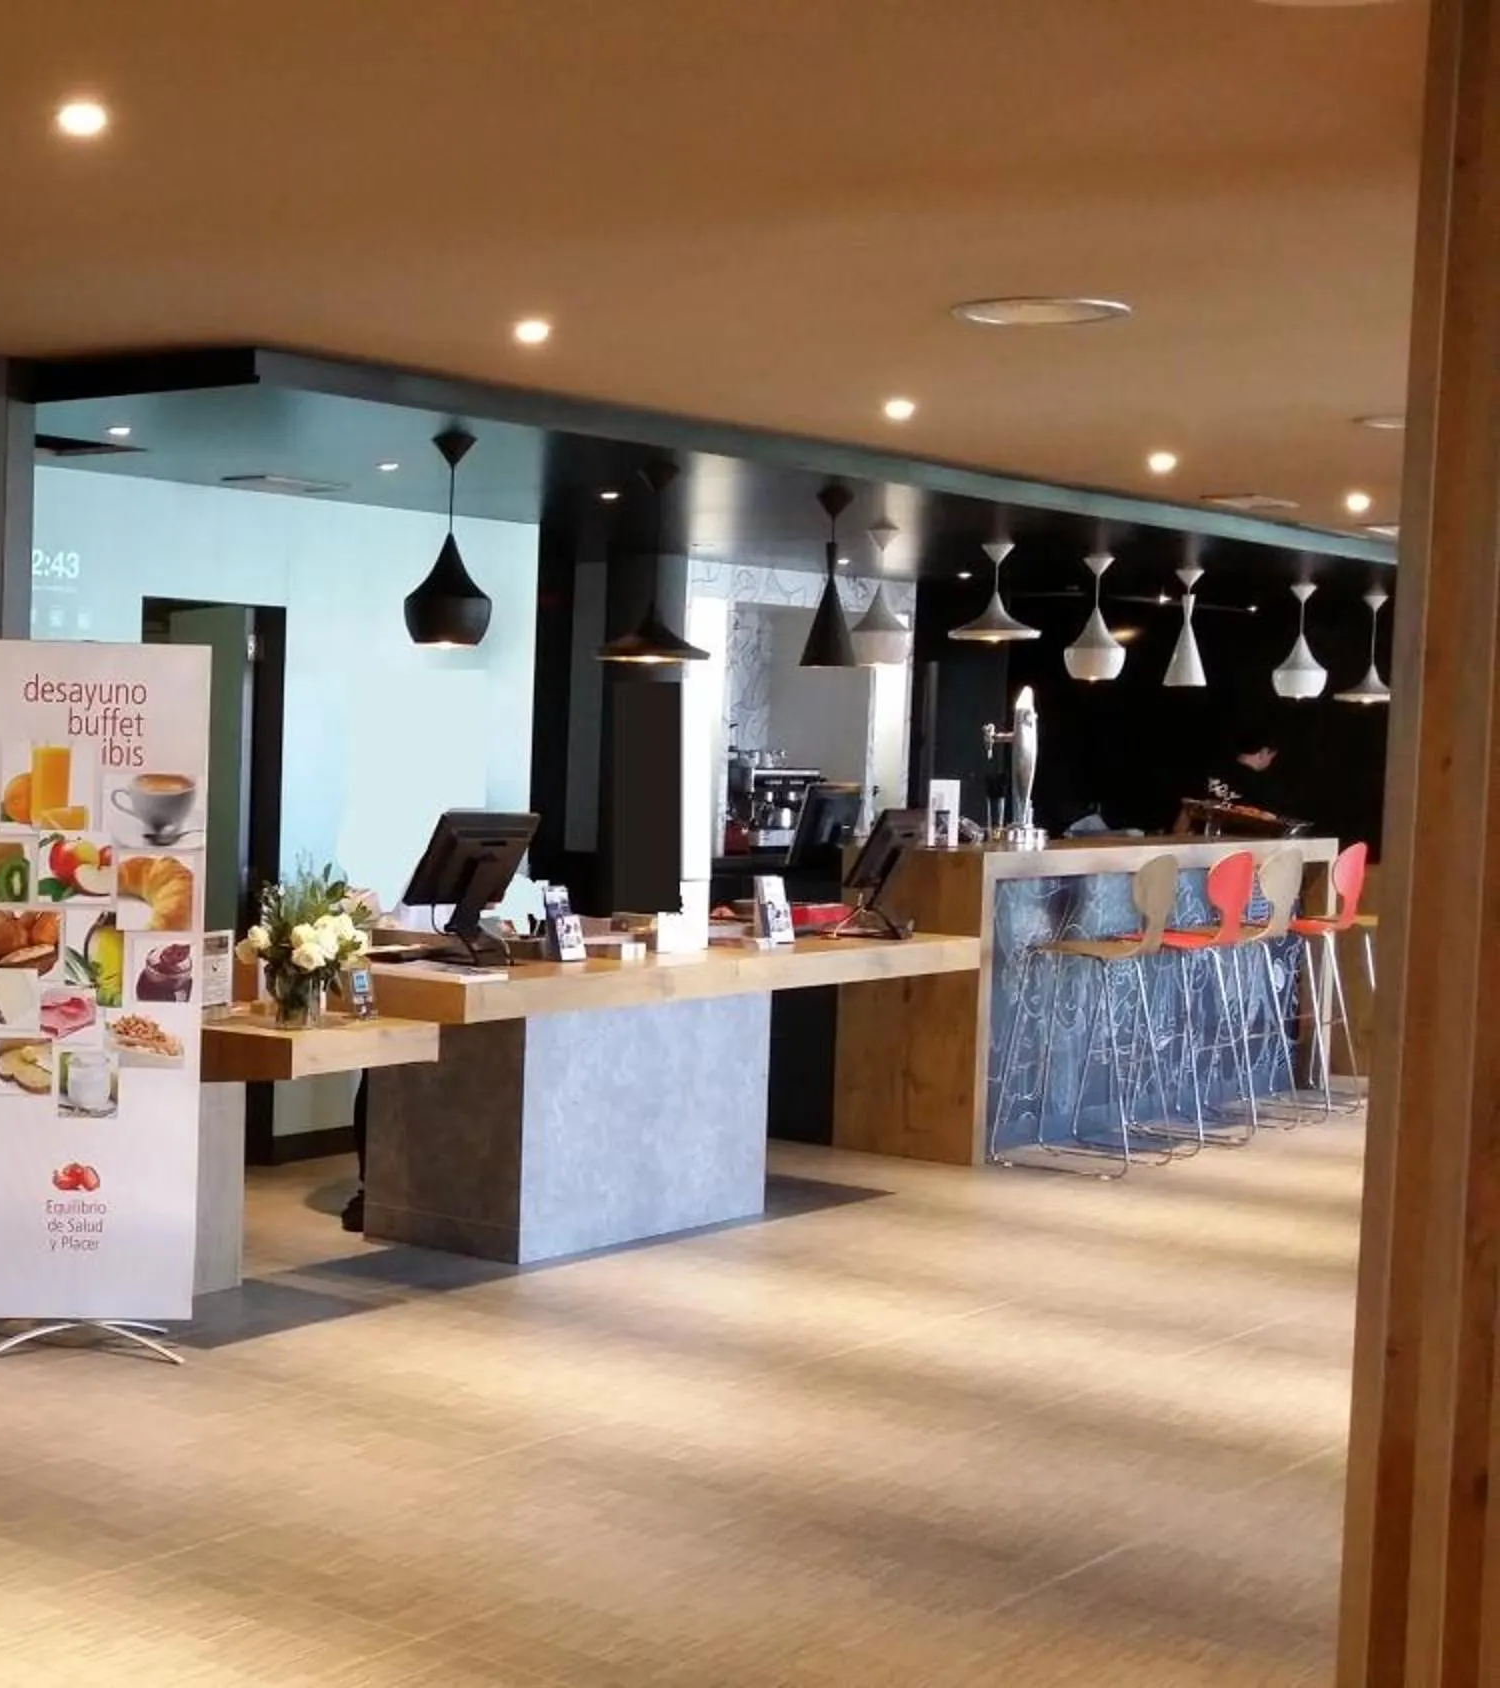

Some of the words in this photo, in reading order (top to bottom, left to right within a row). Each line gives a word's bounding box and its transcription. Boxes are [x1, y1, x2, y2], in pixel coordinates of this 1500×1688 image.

[23, 674, 147, 711] desayuno
[68, 707, 145, 738] buffet
[101, 738, 145, 768] ibis
[45, 1200, 108, 1215] Equilibrio
[47, 1218, 64, 1233] de
[67, 1218, 104, 1233] Salud
[49, 1238, 57, 1251] y
[61, 1235, 99, 1251] Placer
